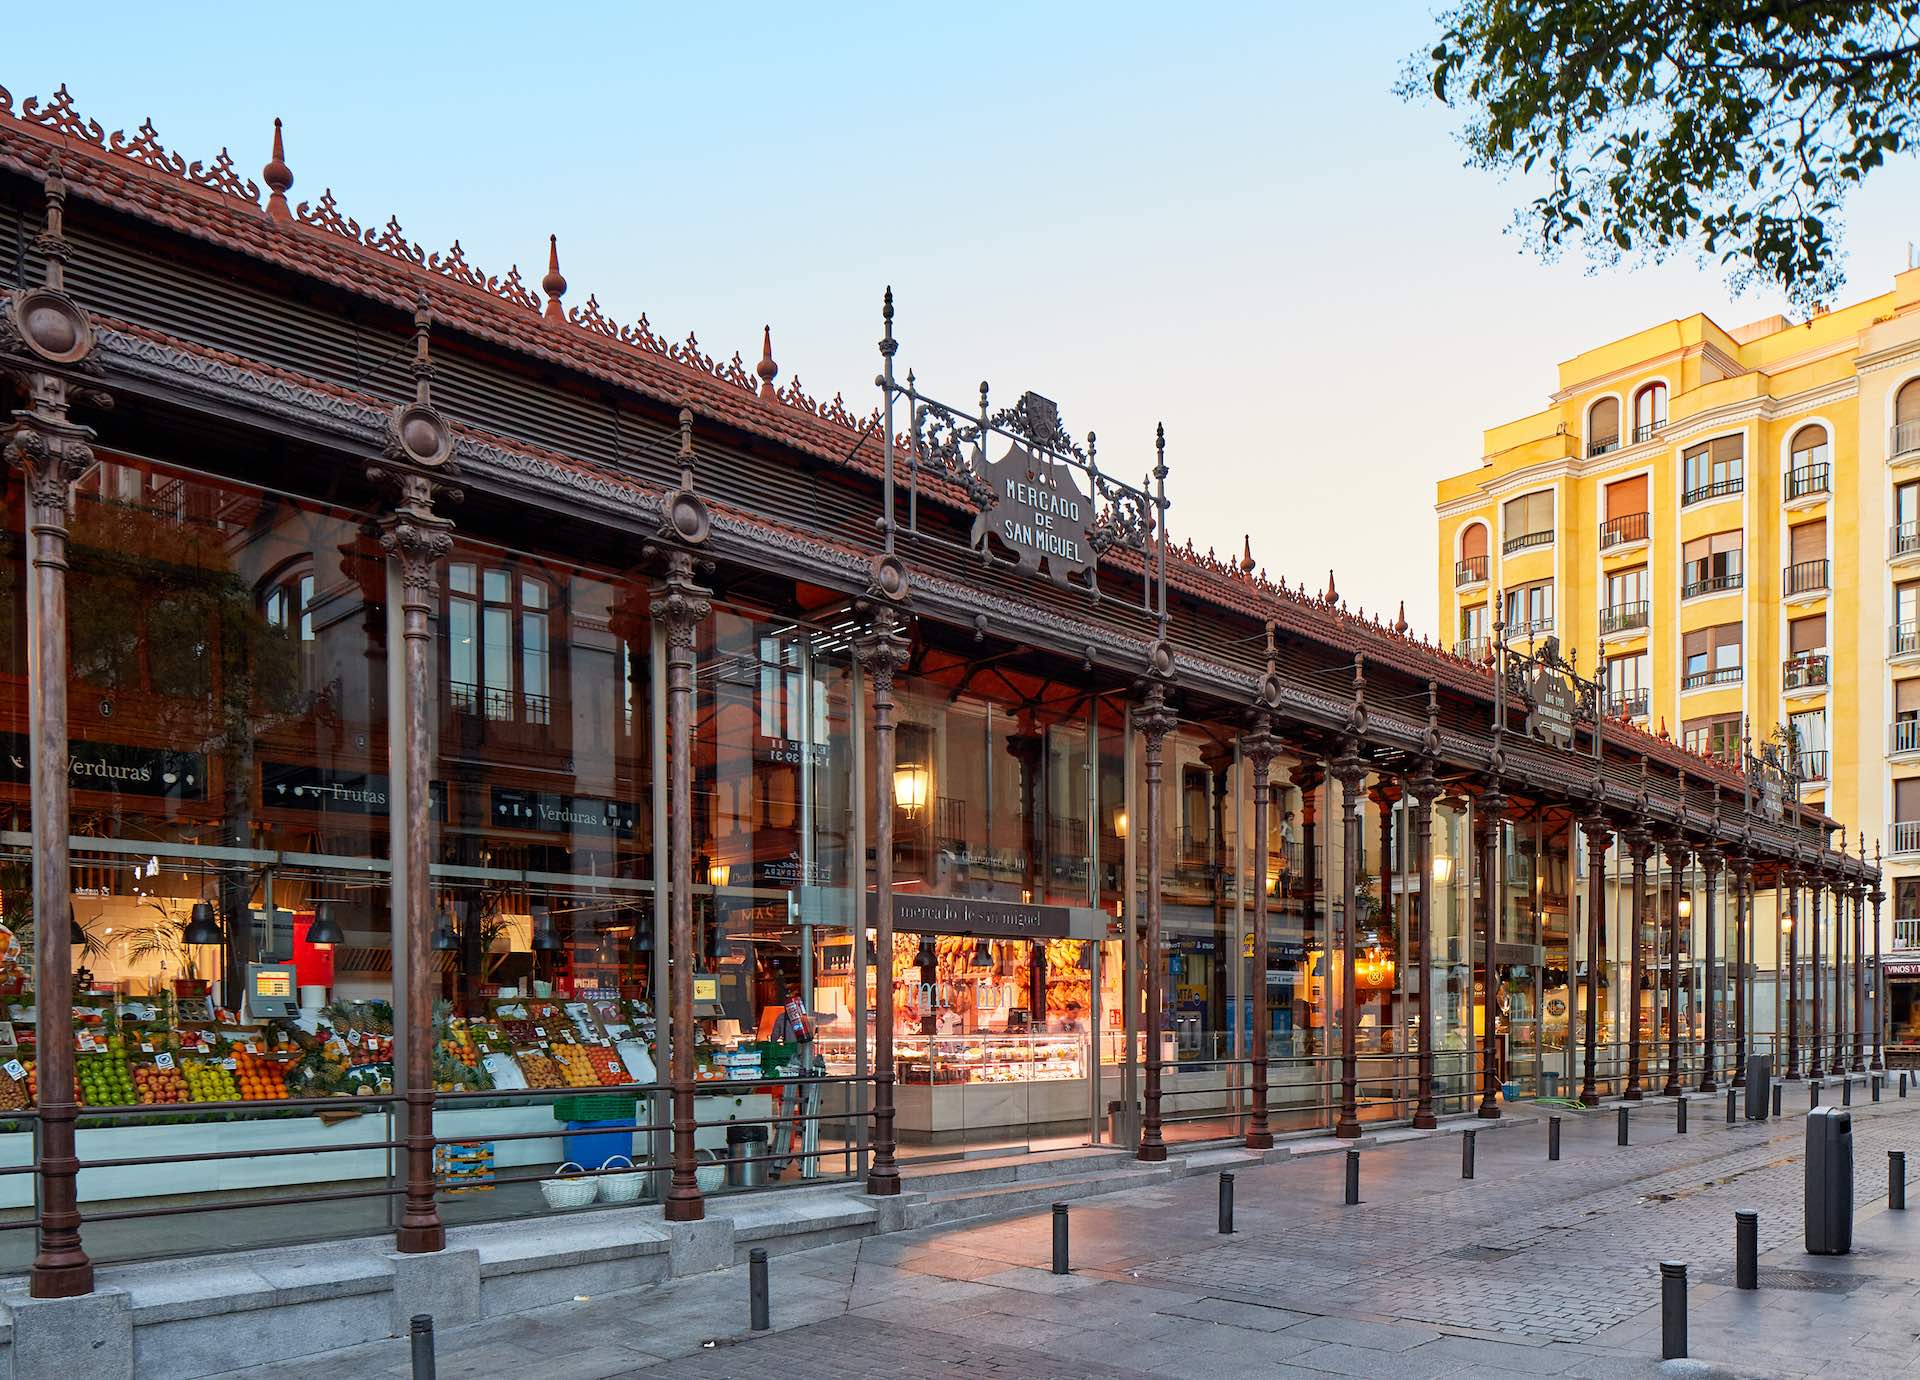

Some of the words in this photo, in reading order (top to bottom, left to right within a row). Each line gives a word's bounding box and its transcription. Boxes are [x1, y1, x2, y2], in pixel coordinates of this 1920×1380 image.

[1006, 479, 1079, 522] MERCADO
[1035, 513, 1053, 530] DE
[1005, 519, 1032, 546] SAN
[1036, 529, 1084, 564] MIGUEL
[333, 783, 386, 804] Frutas
[538, 803, 597, 825] Verduras
[900, 903, 957, 920] mercado
[1002, 911, 1040, 927] miguel
[1888, 965, 1910, 973] VINOS
[1910, 965, 1916, 973] Y
